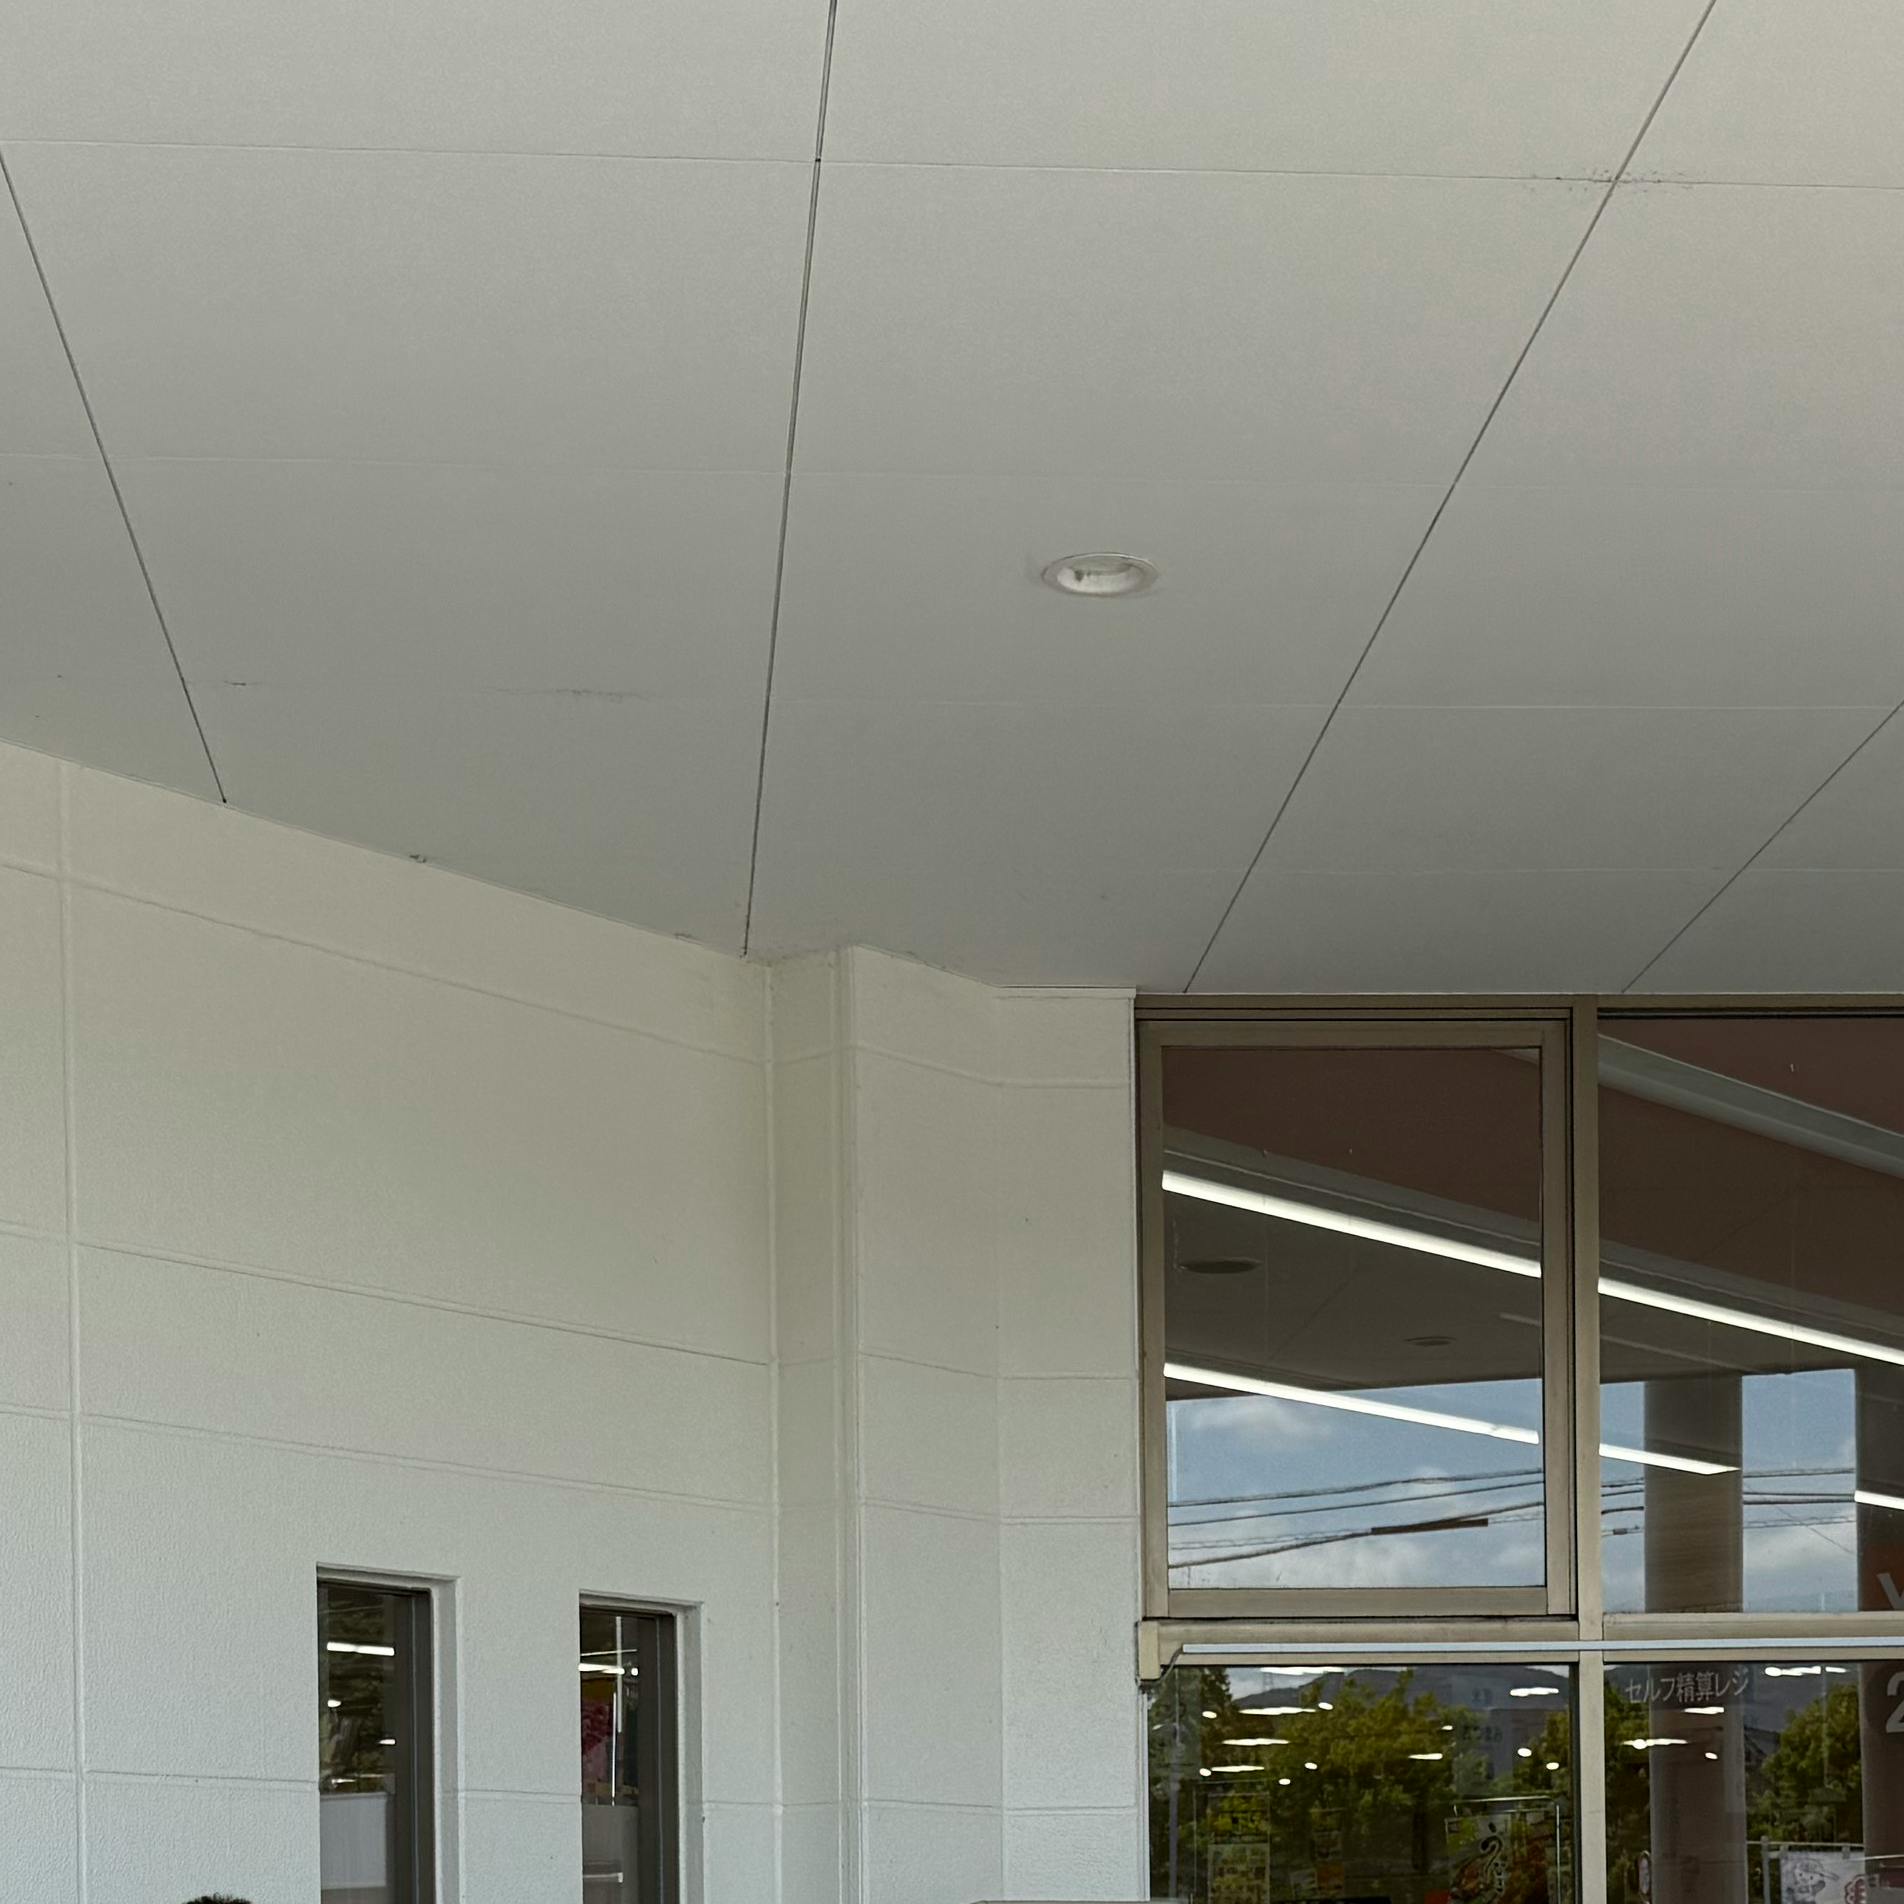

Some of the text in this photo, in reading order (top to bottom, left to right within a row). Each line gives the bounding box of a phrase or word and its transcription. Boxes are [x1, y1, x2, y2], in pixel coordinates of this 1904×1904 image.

[1625, 1666, 1750, 1703] セルフ精算レジ
